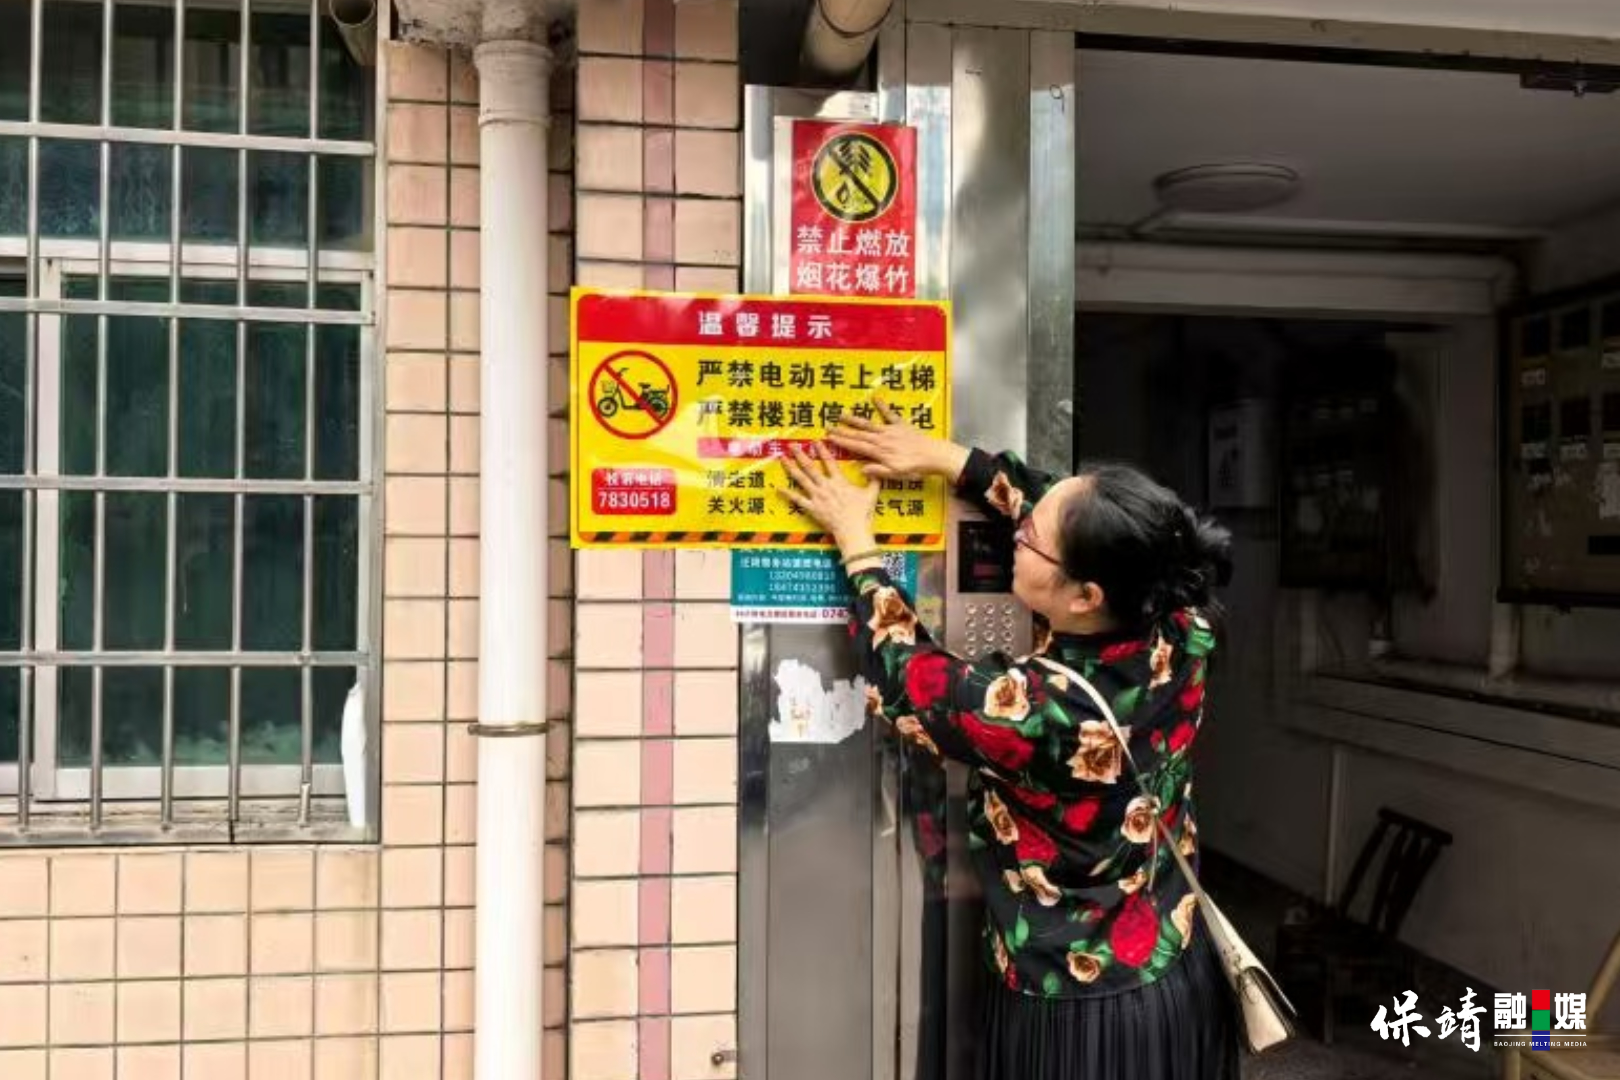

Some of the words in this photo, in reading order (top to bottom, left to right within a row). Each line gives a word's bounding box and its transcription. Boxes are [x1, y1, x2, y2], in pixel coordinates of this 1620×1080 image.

[797, 226, 910, 257] 禁止燃放
[797, 262, 909, 292] 烟花爆竹
[699, 311, 832, 339] 温馨提示
[696, 360, 935, 391] 严禁电动车上电梯
[598, 491, 671, 509] 7830518
